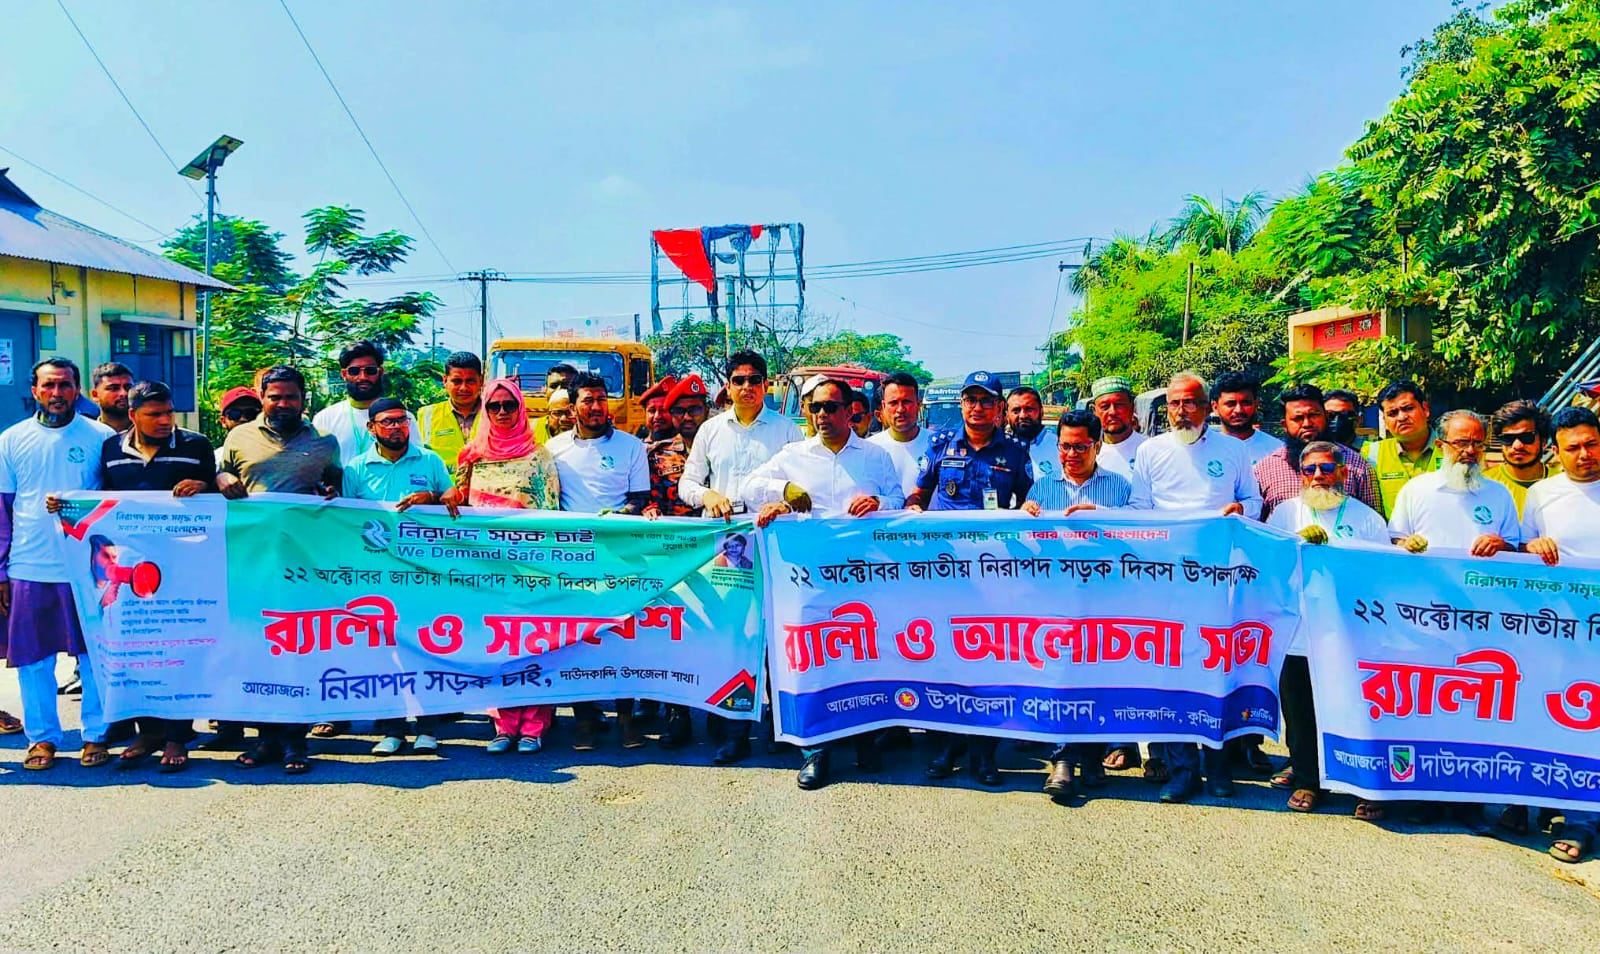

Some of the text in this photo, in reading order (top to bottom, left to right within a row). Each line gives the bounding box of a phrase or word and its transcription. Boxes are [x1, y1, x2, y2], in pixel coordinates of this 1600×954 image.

[398, 522, 594, 545] নিরাপদ সড়ক চাই
[873, 529, 916, 541] নিরাপদ
[921, 531, 953, 541] সড়ক
[1102, 530, 1168, 540] বাংলাদেশ
[397, 546, 425, 558] We
[431, 547, 501, 559] Demand
[507, 549, 545, 560] Safe
[551, 549, 594, 561] Road
[790, 552, 1260, 588] ২২ অক্টোবর জাতীয় নিরাপদ সড়ক দিবস উপলক্ষে
[284, 565, 664, 593] ২২ অক্টোবর জাতীয় নিরাপদ সড়ক দিবস উপলক্ষে
[1465, 571, 1519, 588] নিরাপদ
[1524, 579, 1563, 592] সড়ক
[262, 596, 685, 656] র‍্যালী ও সমাবেশ
[1354, 599, 1387, 624] ২২
[1396, 600, 1492, 631] অক্টোবর
[1500, 608, 1579, 640] জাতীয়
[895, 618, 936, 662] ও
[950, 615, 1184, 670] আলোচনা
[1200, 620, 1273, 675] সভা
[320, 668, 417, 701] নিরাপদ
[425, 670, 492, 695] সড়ক
[502, 664, 552, 688] চাই,
[560, 667, 617, 680] দাউদকান্দি
[621, 666, 668, 680] উপজেলা
[1357, 649, 1600, 732] র‍্যালী ও
[925, 686, 1017, 718] উপজেলা
[1187, 709, 1222, 729] কুমিল্লা
[1419, 748, 1523, 782] দাউদকান্দি
